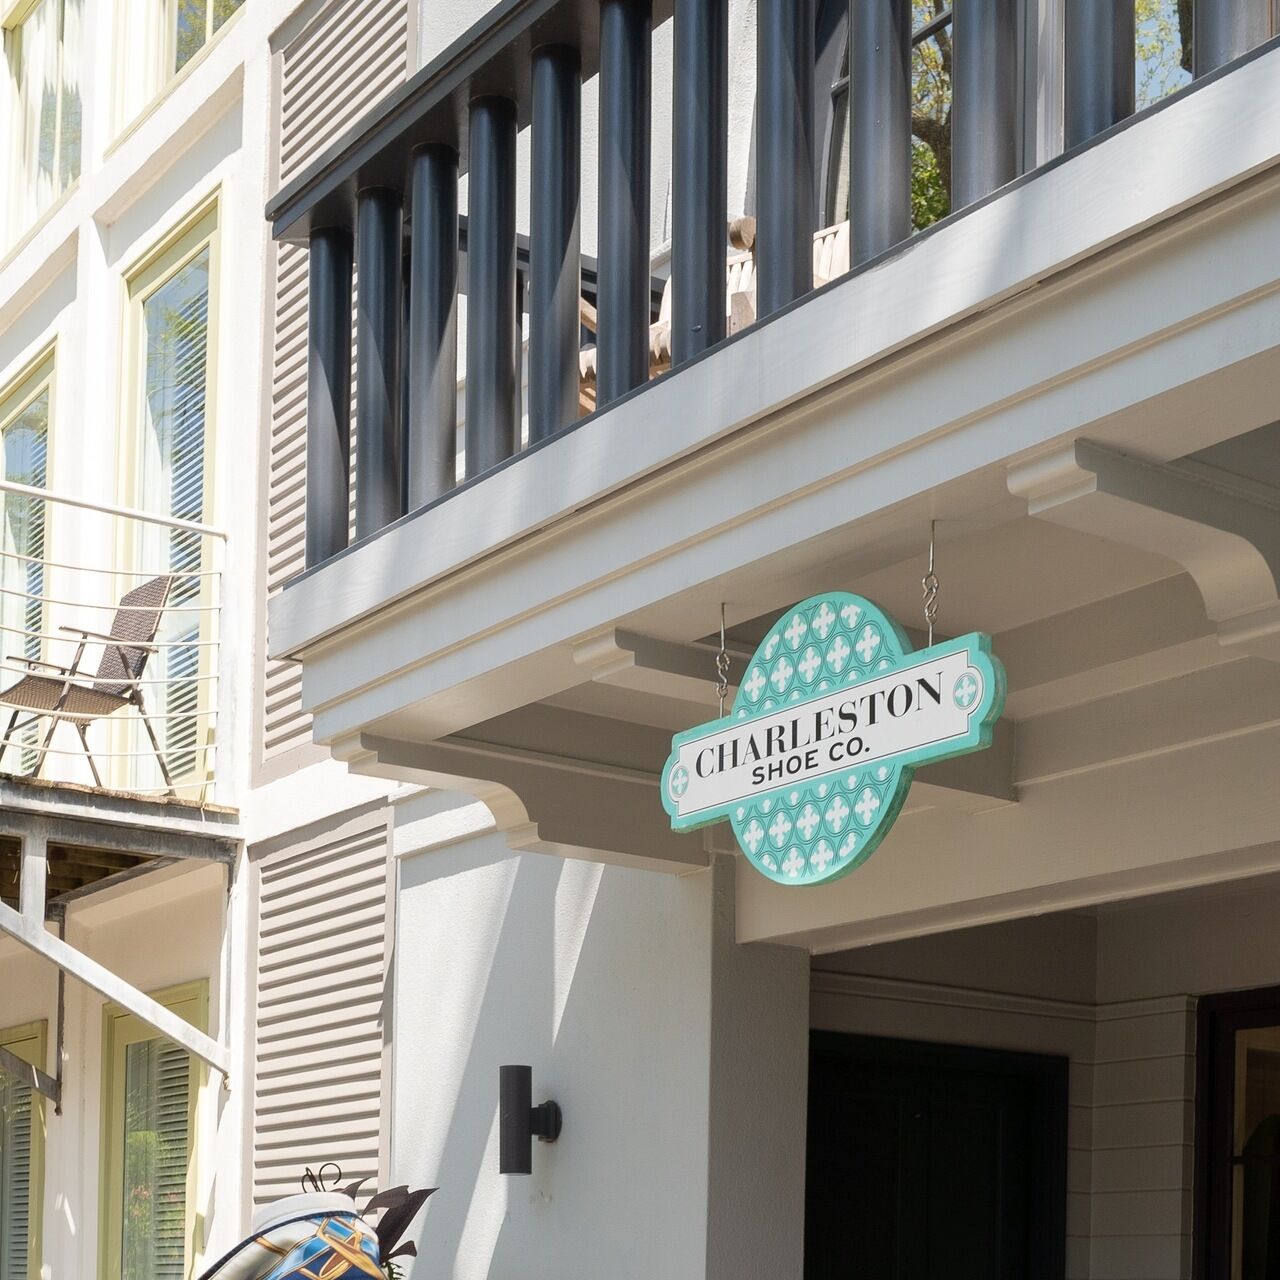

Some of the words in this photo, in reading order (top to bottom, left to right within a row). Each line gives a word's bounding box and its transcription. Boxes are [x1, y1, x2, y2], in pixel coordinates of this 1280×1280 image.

[695, 671, 945, 779] CHARLESTON
[751, 748, 819, 785] SHOE
[828, 736, 871, 762] CO.
